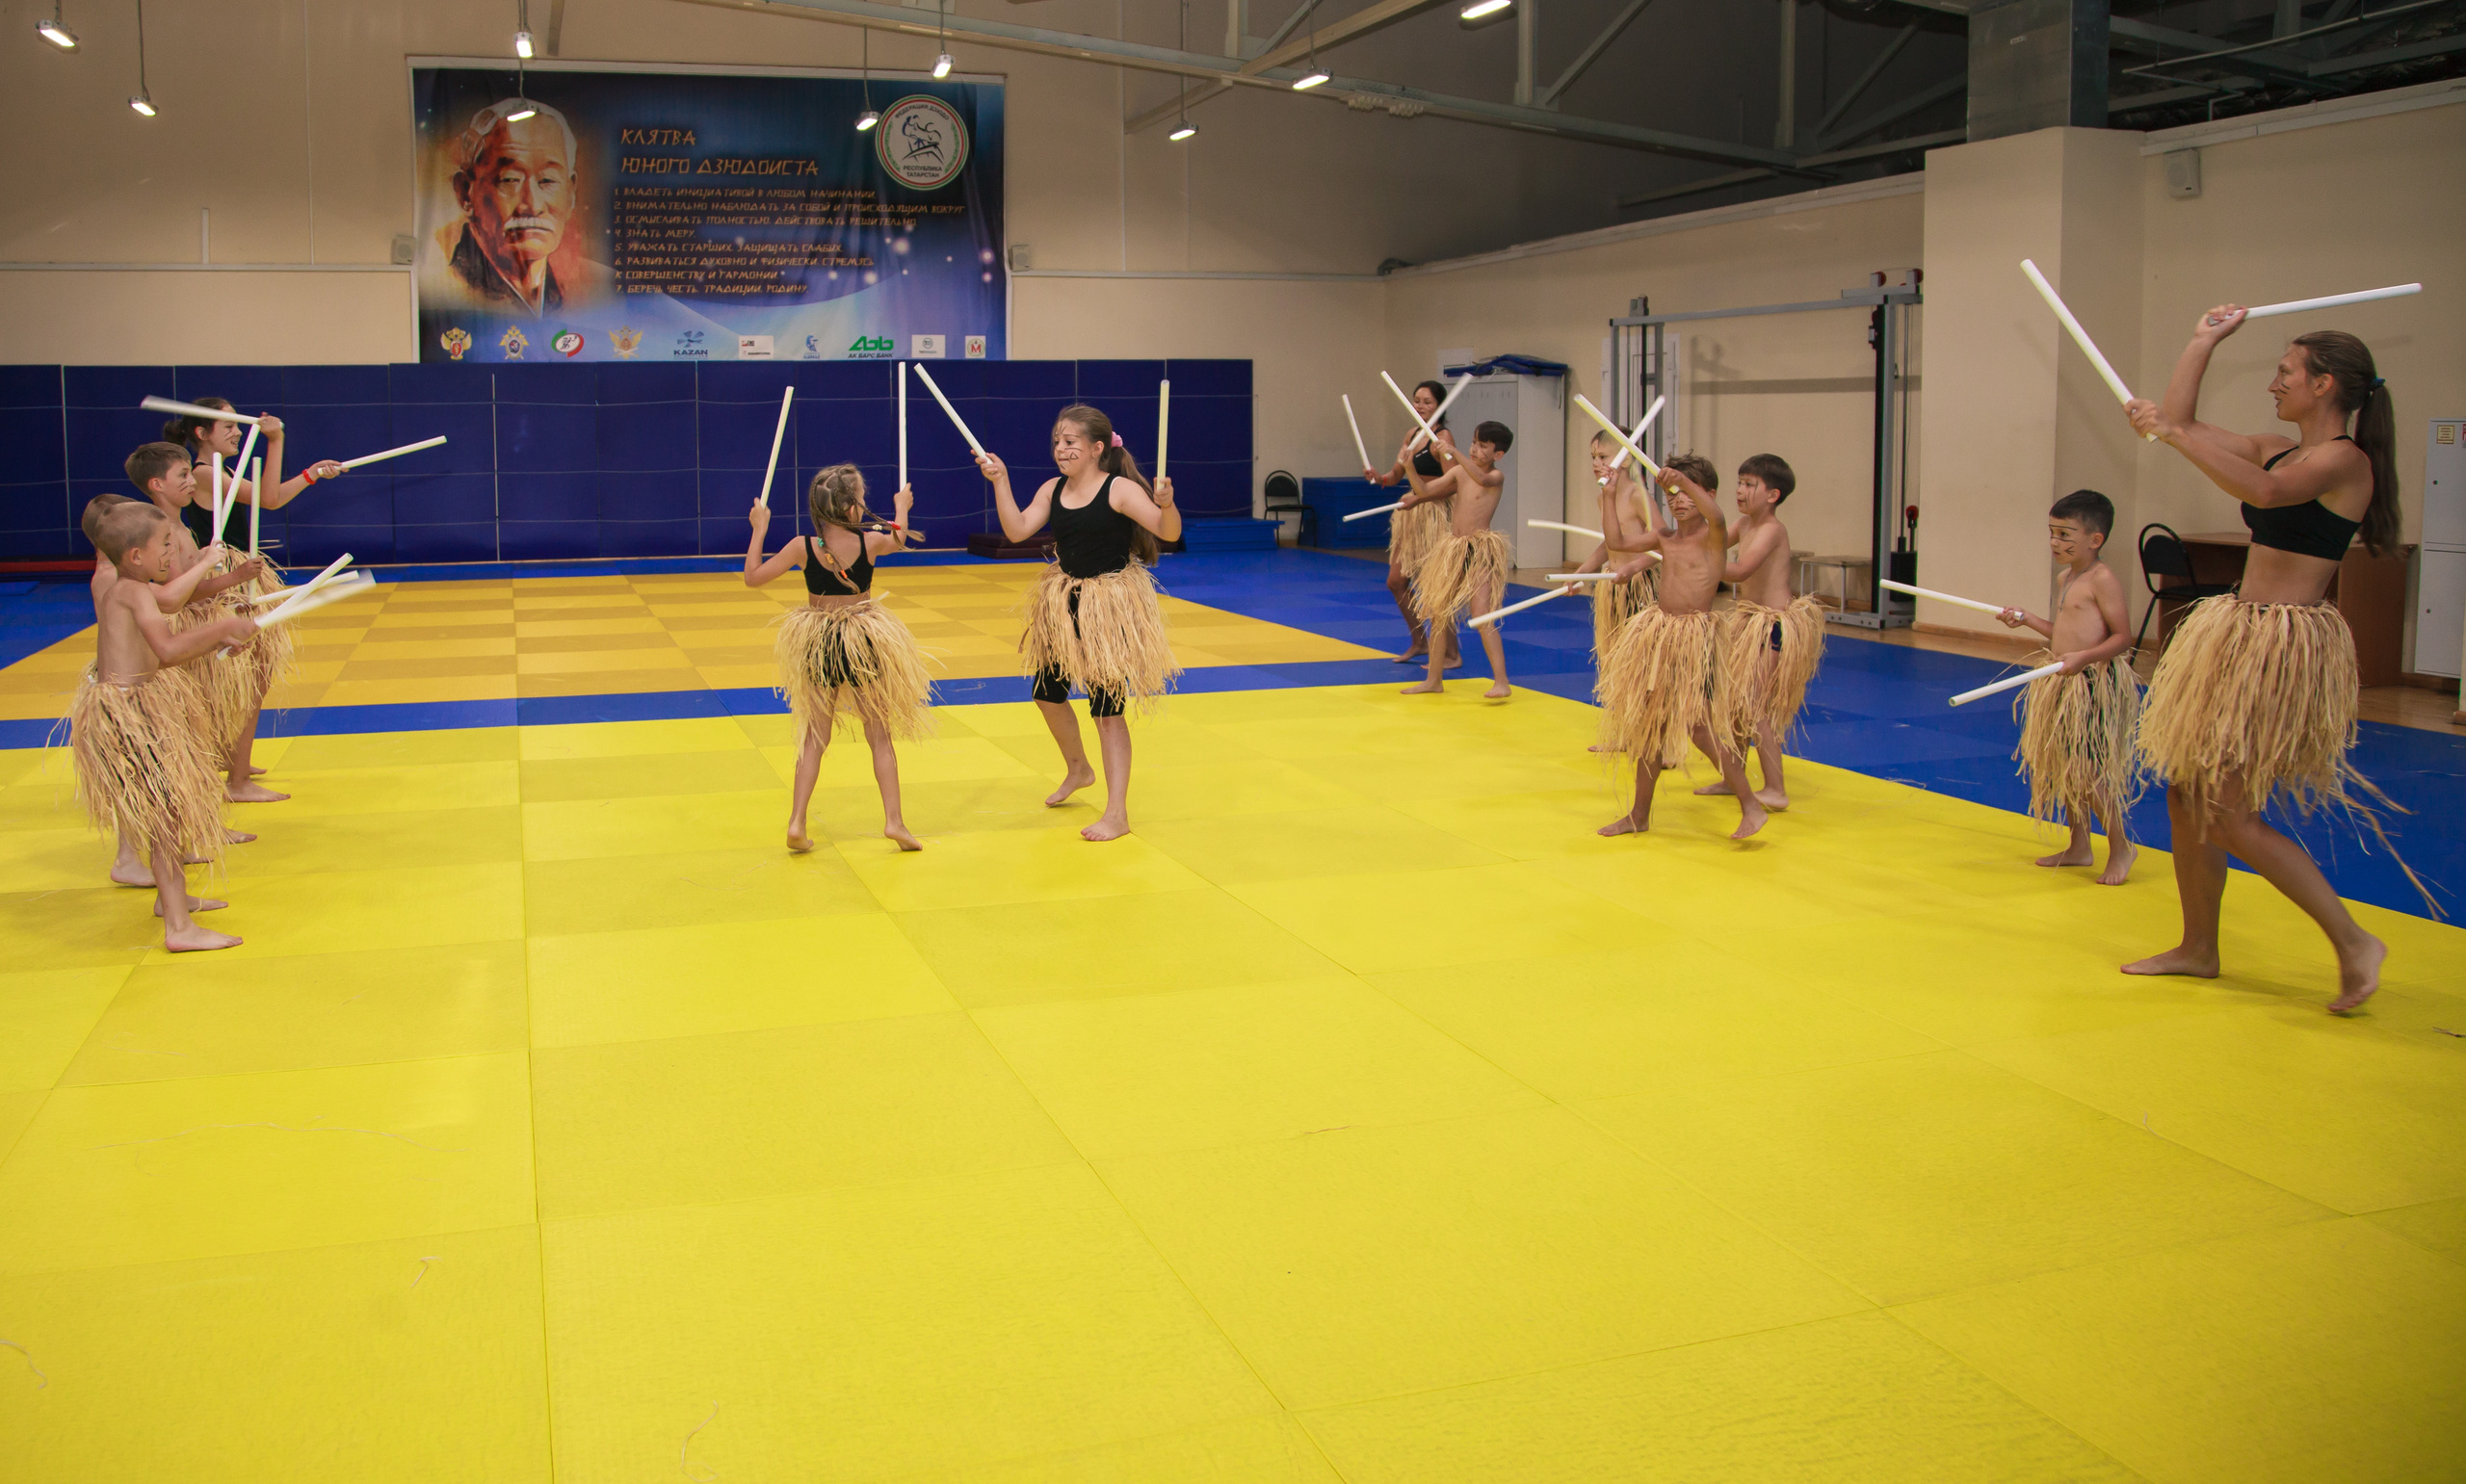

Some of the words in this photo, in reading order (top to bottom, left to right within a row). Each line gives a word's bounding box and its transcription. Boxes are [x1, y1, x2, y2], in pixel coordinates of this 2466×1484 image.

[930, 105, 950, 120] ДЗЮДО
[621, 128, 696, 145] КЛЯТВА
[621, 157, 691, 174] ЮНОГО
[696, 158, 819, 176] ДЗЮДОИСТА
[624, 187, 673, 196] ВЛАДЕТЬ
[676, 187, 755, 199] ИНИЦИАТИВОЙ
[757, 189, 764, 197] В
[766, 189, 806, 198] ЛЮБОМ
[626, 201, 708, 211] ВНИМАТЕЛЬНО
[711, 202, 779, 212] НАБЛЮДАТЬ
[782, 203, 797, 212] ЗА
[800, 202, 830, 212] СОБОЙ
[833, 203, 841, 212] И
[844, 203, 929, 216] ПРОИСХОДЯЩИМ
[625, 215, 702, 224] ОСМЫСЛИВАТЬ
[774, 215, 846, 226] ДЕЙСТВОВАТЬ
[626, 229, 662, 238] ЗНАТЬ
[627, 243, 679, 252] УВАЖАТЬ
[737, 243, 799, 255] ЗАЩИЩАТЬ
[626, 257, 697, 266] РАЗВИВАТЬСЯ
[699, 257, 748, 267] ДУХОВНО
[749, 257, 758, 266] И
[822, 257, 875, 267] СТРЕМЯСЬ
[625, 271, 705, 280] СОВЕРШЕНСТВУ
[708, 271, 717, 279] И
[627, 284, 663, 294] БЕРЕЧЬ
